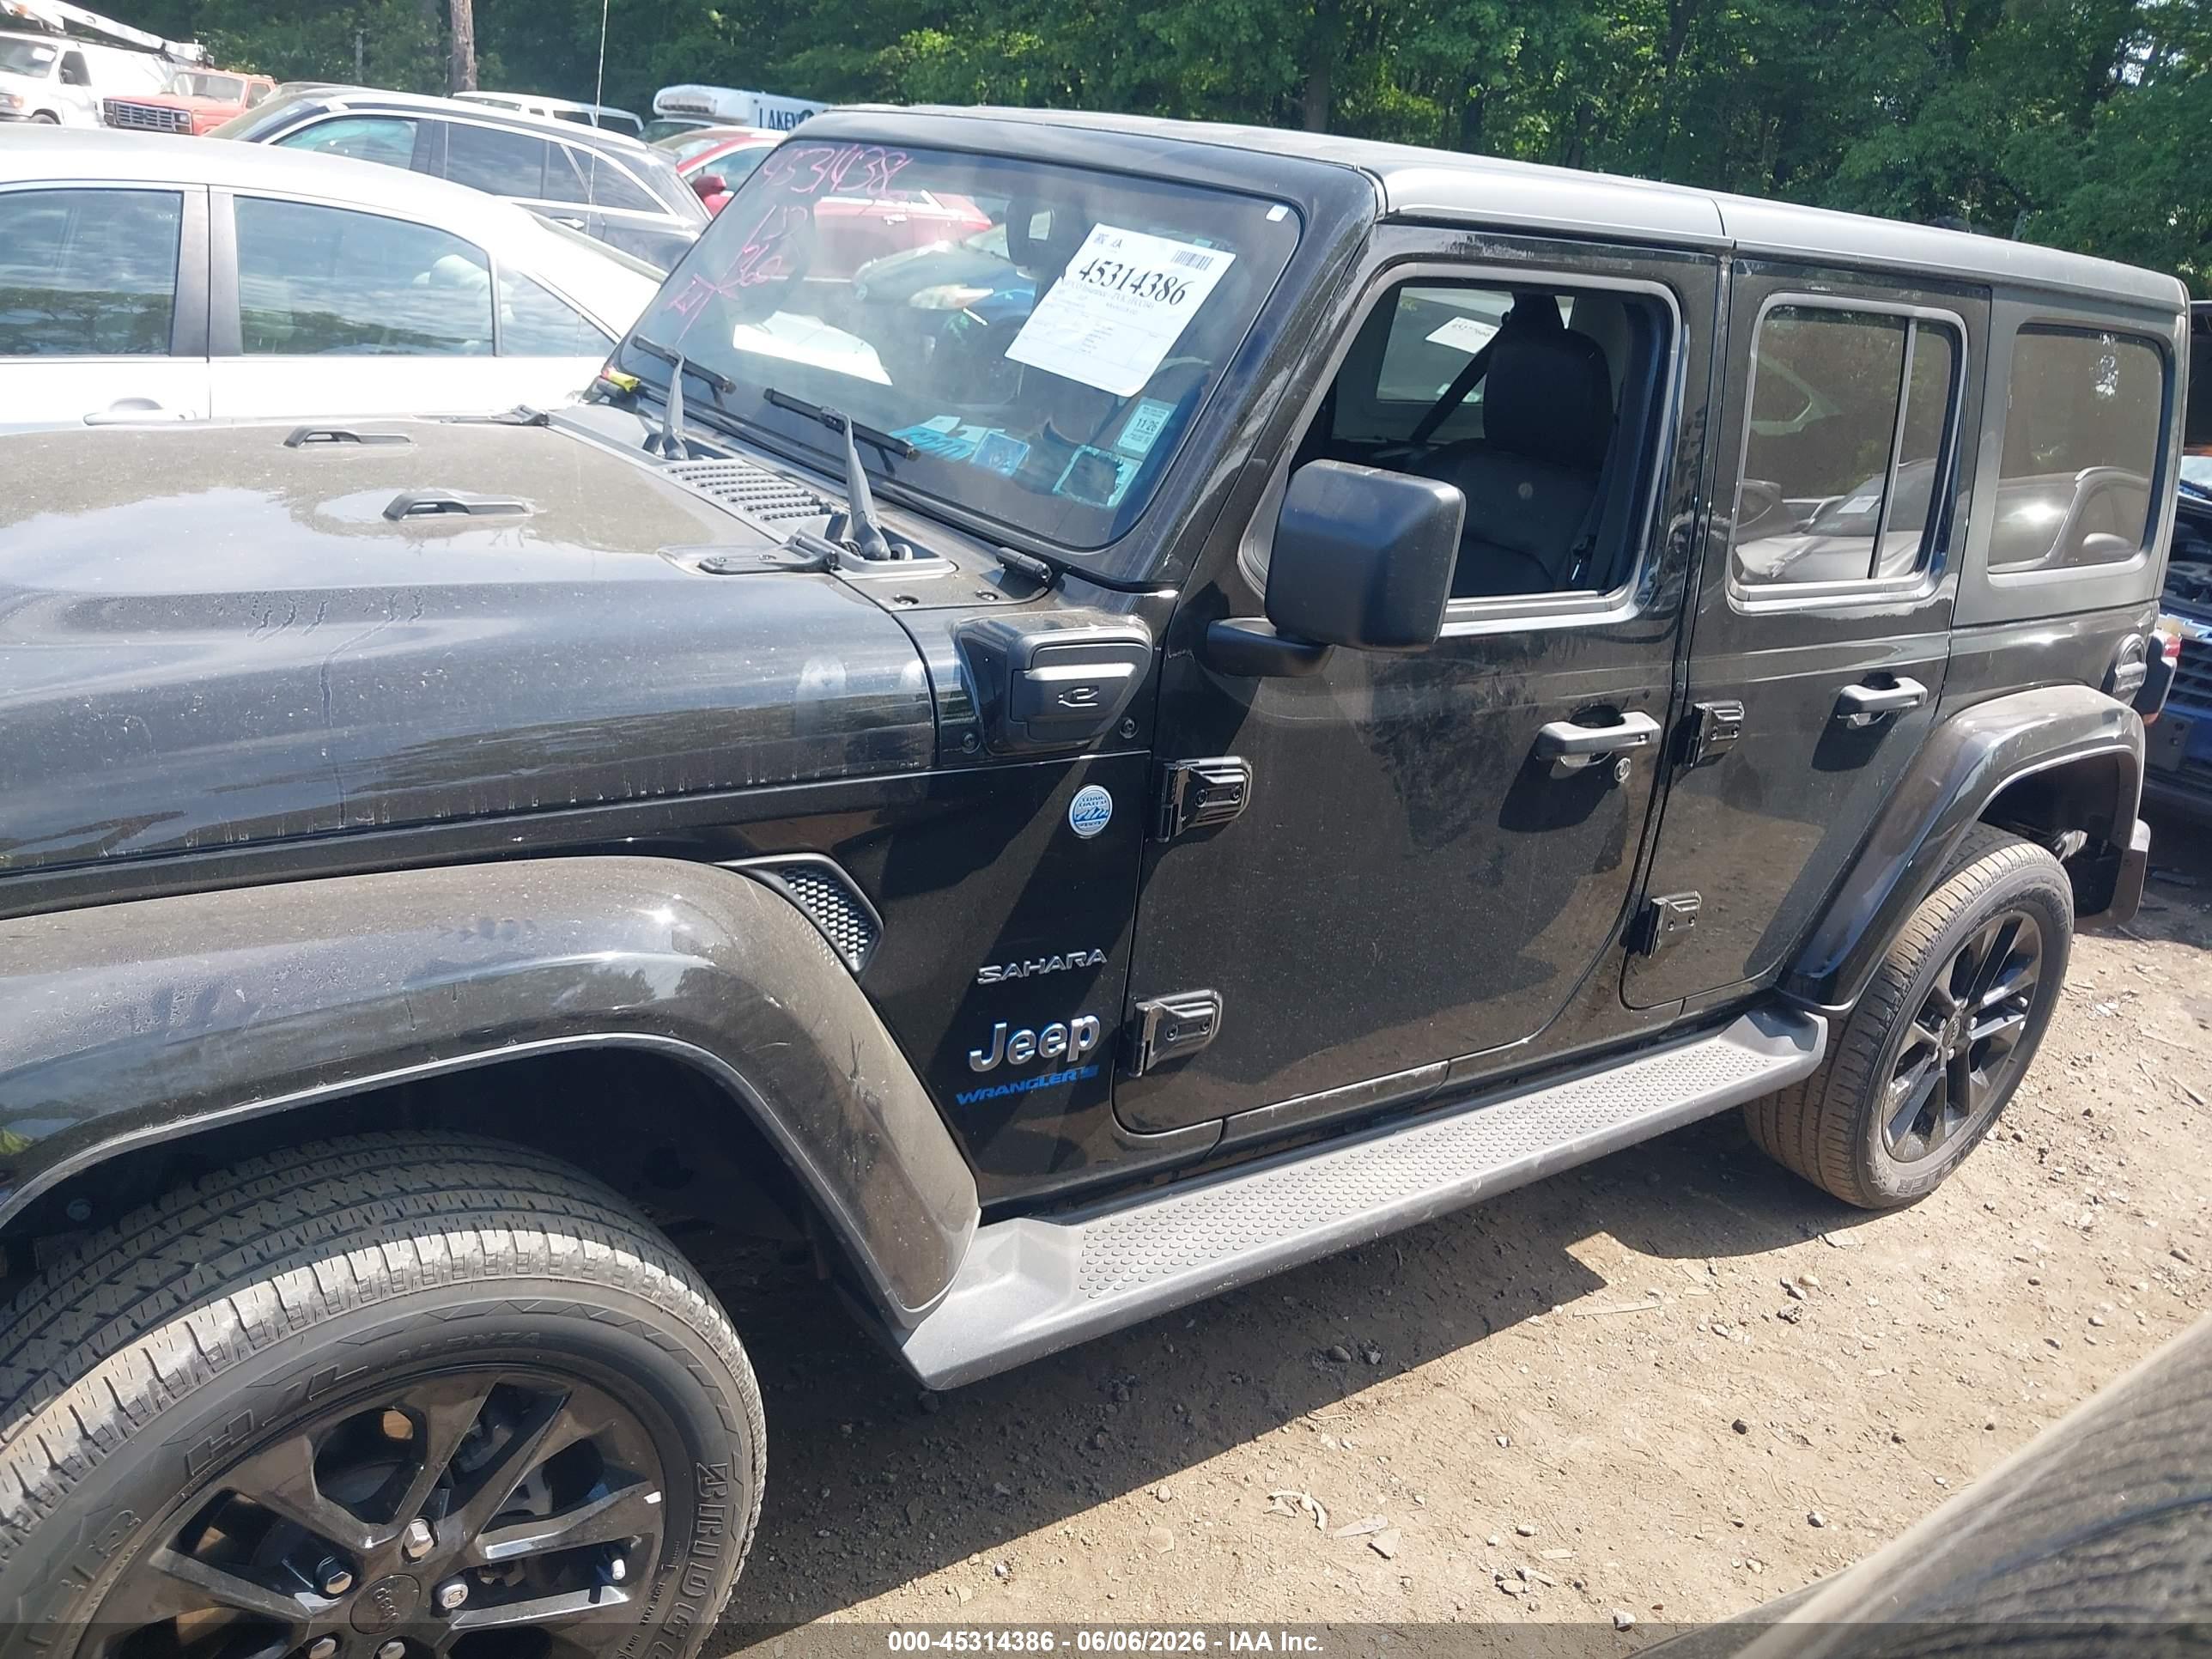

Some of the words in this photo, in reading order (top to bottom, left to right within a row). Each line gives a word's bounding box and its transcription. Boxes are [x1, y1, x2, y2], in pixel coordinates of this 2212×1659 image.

[1079, 258, 1195, 306] 45314386
[977, 948, 1108, 985] SAHARA
[969, 1014, 1101, 1073] Jeep
[956, 1069, 1078, 1105] WRANGLER
